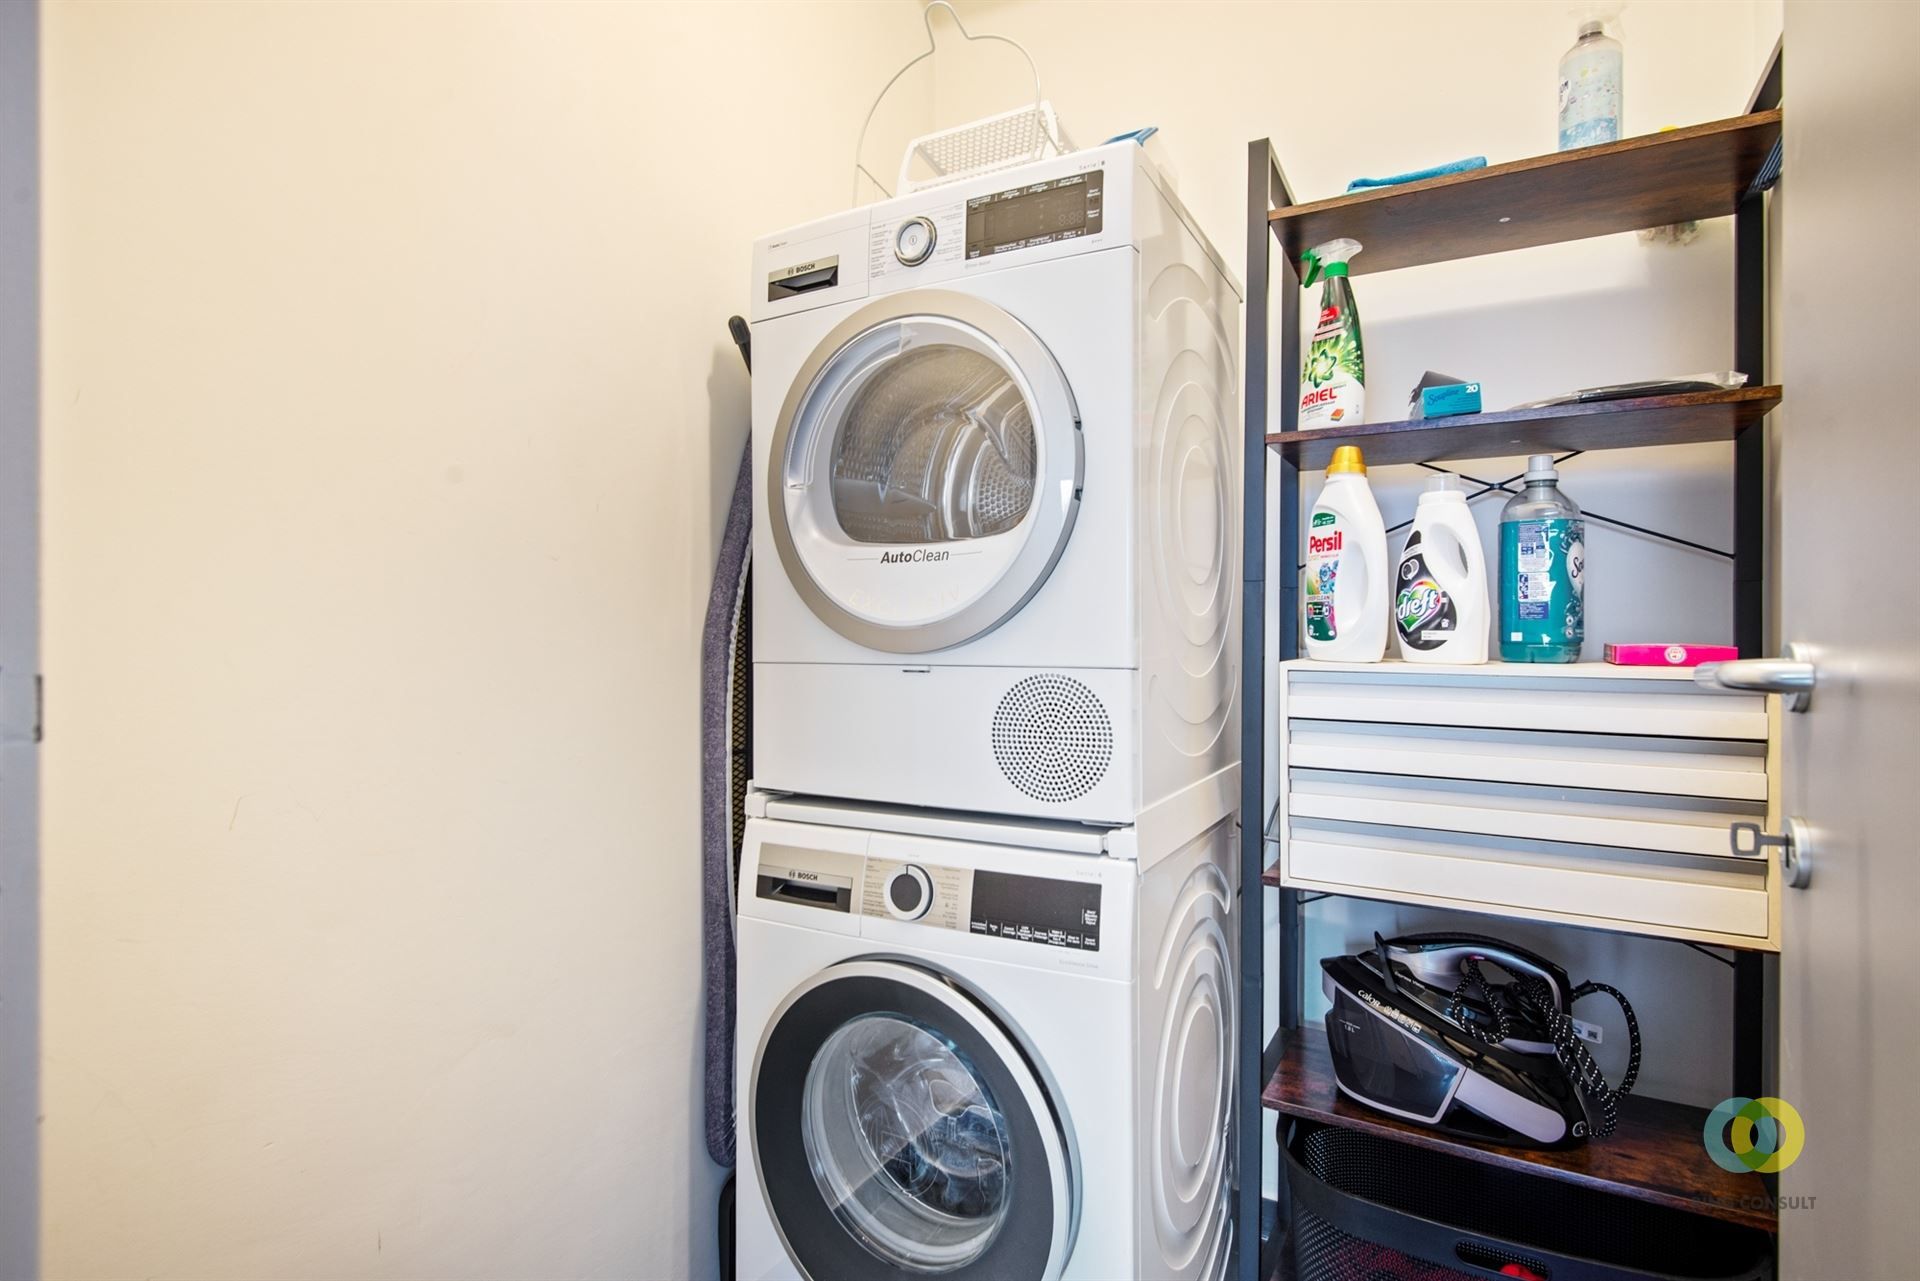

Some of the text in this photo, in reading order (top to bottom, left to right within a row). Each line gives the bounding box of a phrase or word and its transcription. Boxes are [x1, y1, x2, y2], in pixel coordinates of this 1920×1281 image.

[796, 263, 816, 273] BOSCH
[1465, 384, 1479, 394] 20
[1300, 387, 1338, 410] ARIEL
[1309, 530, 1342, 554] Persil
[880, 549, 950, 564] AutoClean
[1397, 590, 1438, 619] dreft
[797, 871, 818, 882] BOSCH
